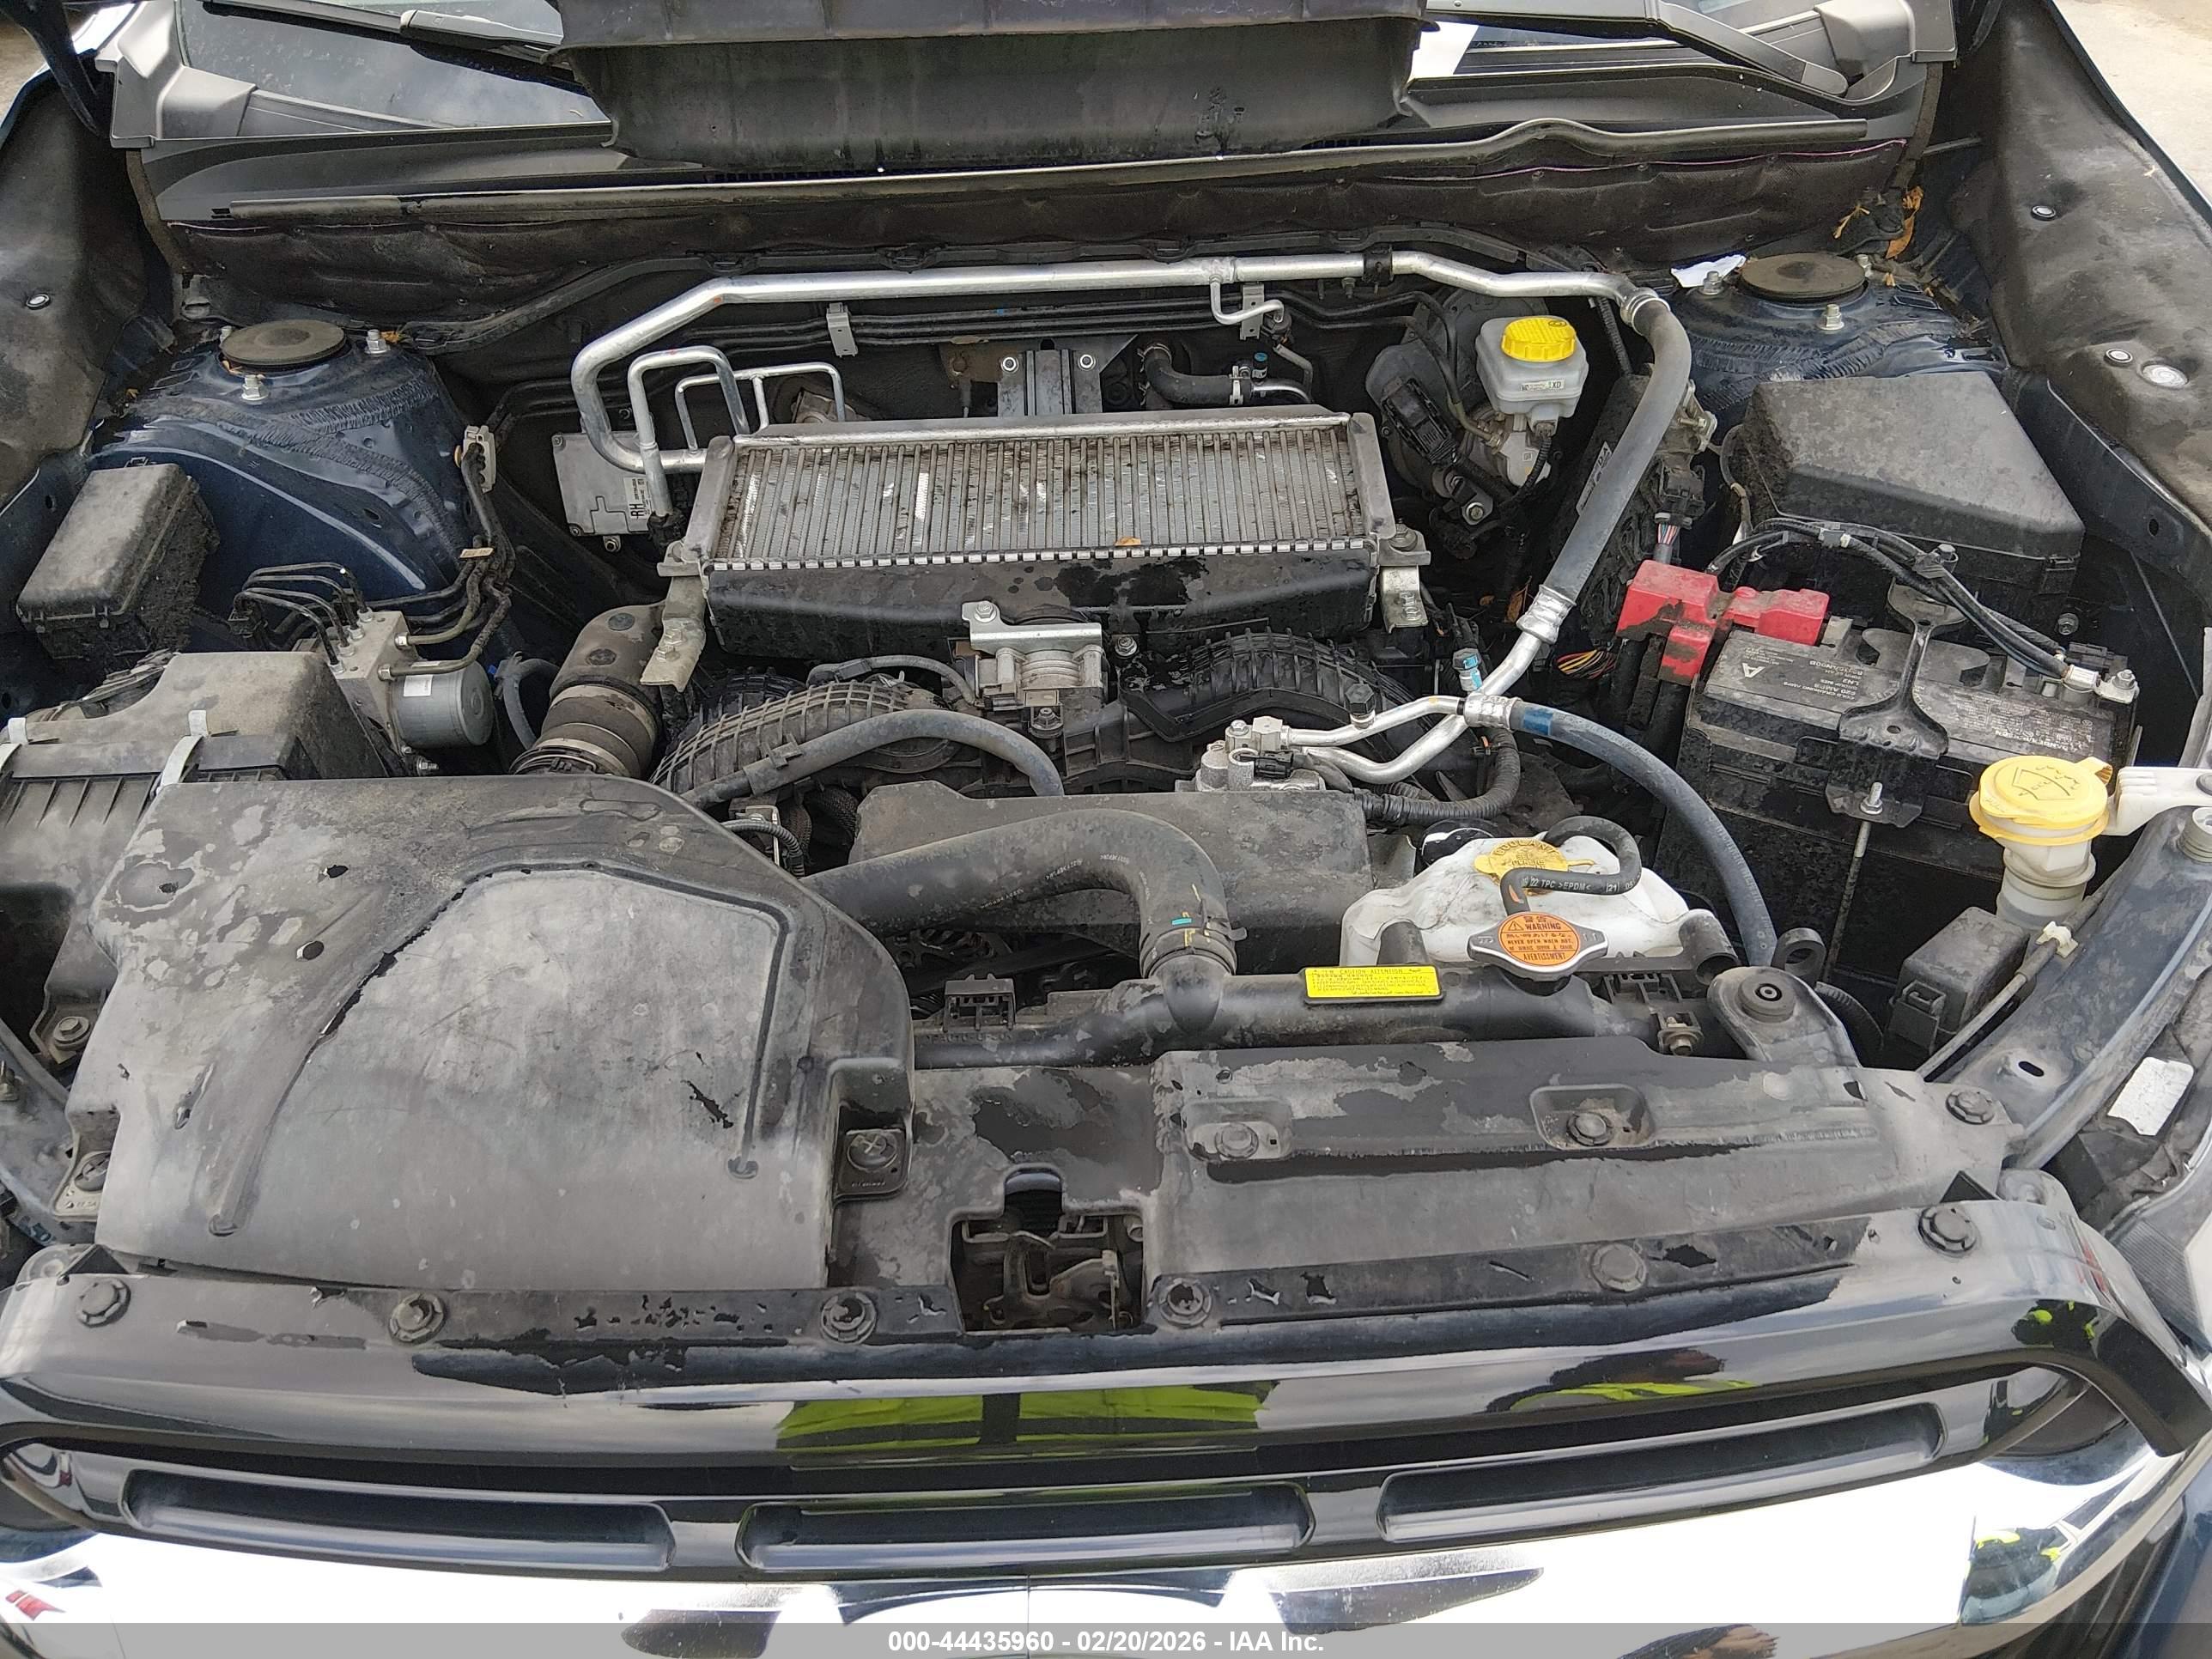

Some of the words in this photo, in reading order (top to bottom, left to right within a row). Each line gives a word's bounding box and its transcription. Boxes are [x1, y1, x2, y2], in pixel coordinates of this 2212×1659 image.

[629, 503, 647, 517] RH
[1493, 838, 1561, 855] COOLANT
[1540, 878, 1555, 888] TPC
